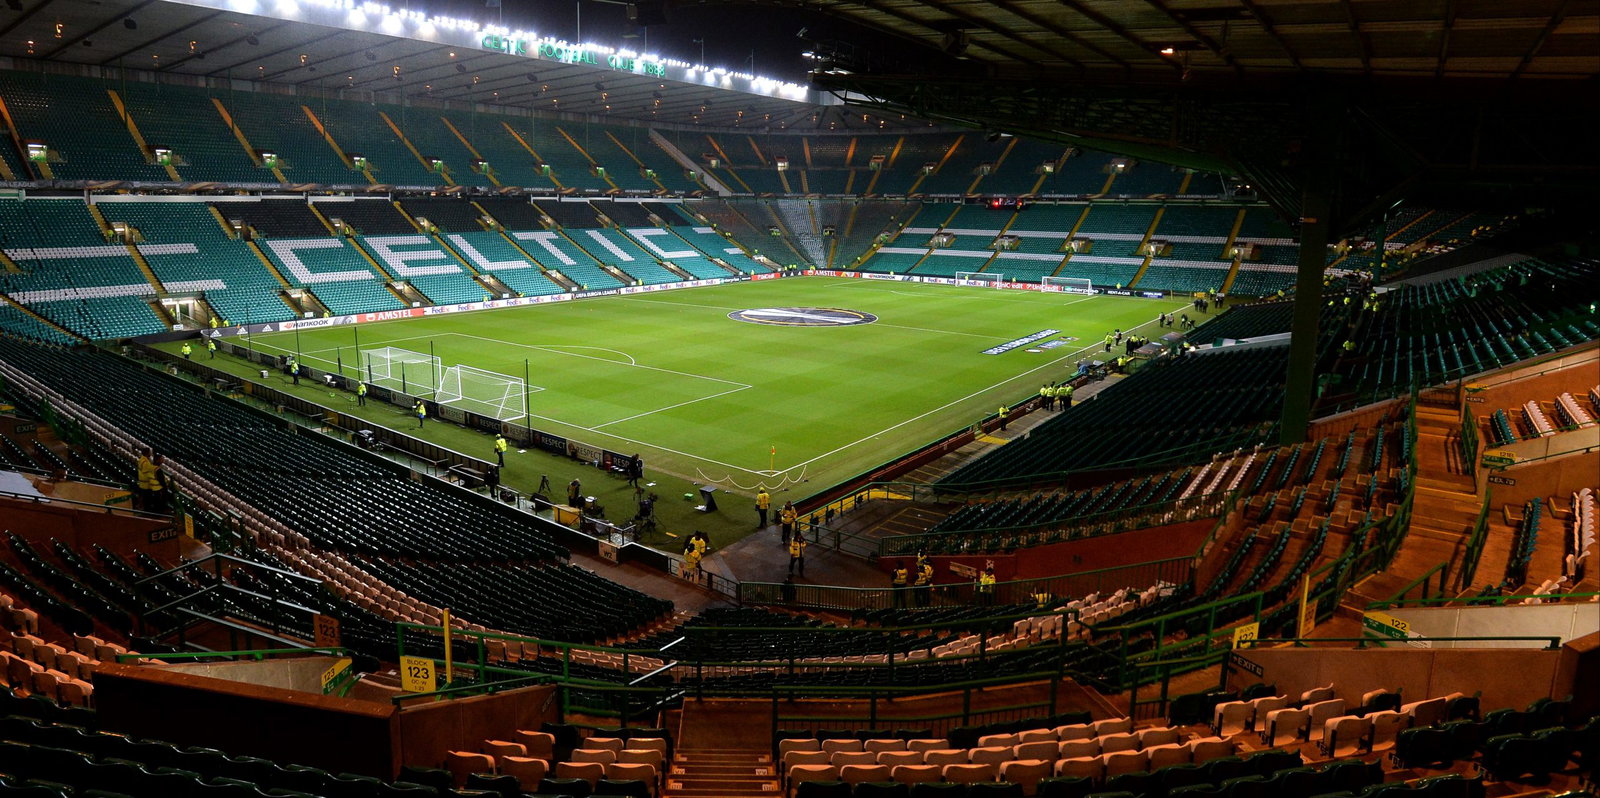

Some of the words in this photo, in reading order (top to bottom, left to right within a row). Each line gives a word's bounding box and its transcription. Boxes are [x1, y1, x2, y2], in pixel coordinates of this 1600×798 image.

[482, 33, 526, 54] CELTIC
[538, 43, 598, 65] FOOTBALL
[607, 55, 634, 71] CLUB
[267, 228, 701, 284] CELTIC
[431, 306, 449, 314] FedEx
[506, 298, 522, 306] FedEx
[529, 296, 544, 304] FedEx
[550, 294, 565, 302] FedEx
[378, 309, 414, 321] AMSTEL
[480, 417, 500, 430] RESPECT
[541, 435, 566, 449] RESPECT
[576, 446, 601, 460] RESPECT
[613, 457, 630, 468] RESP
[151, 529, 174, 541] EXIT
[604, 551, 613, 559] W2
[682, 569, 695, 581] W1
[319, 623, 335, 638] 123
[1391, 618, 1407, 631] 122
[406, 658, 428, 667] BLOCK
[1237, 656, 1257, 673] EXIT
[323, 667, 335, 682] 123
[407, 666, 430, 679] 123
